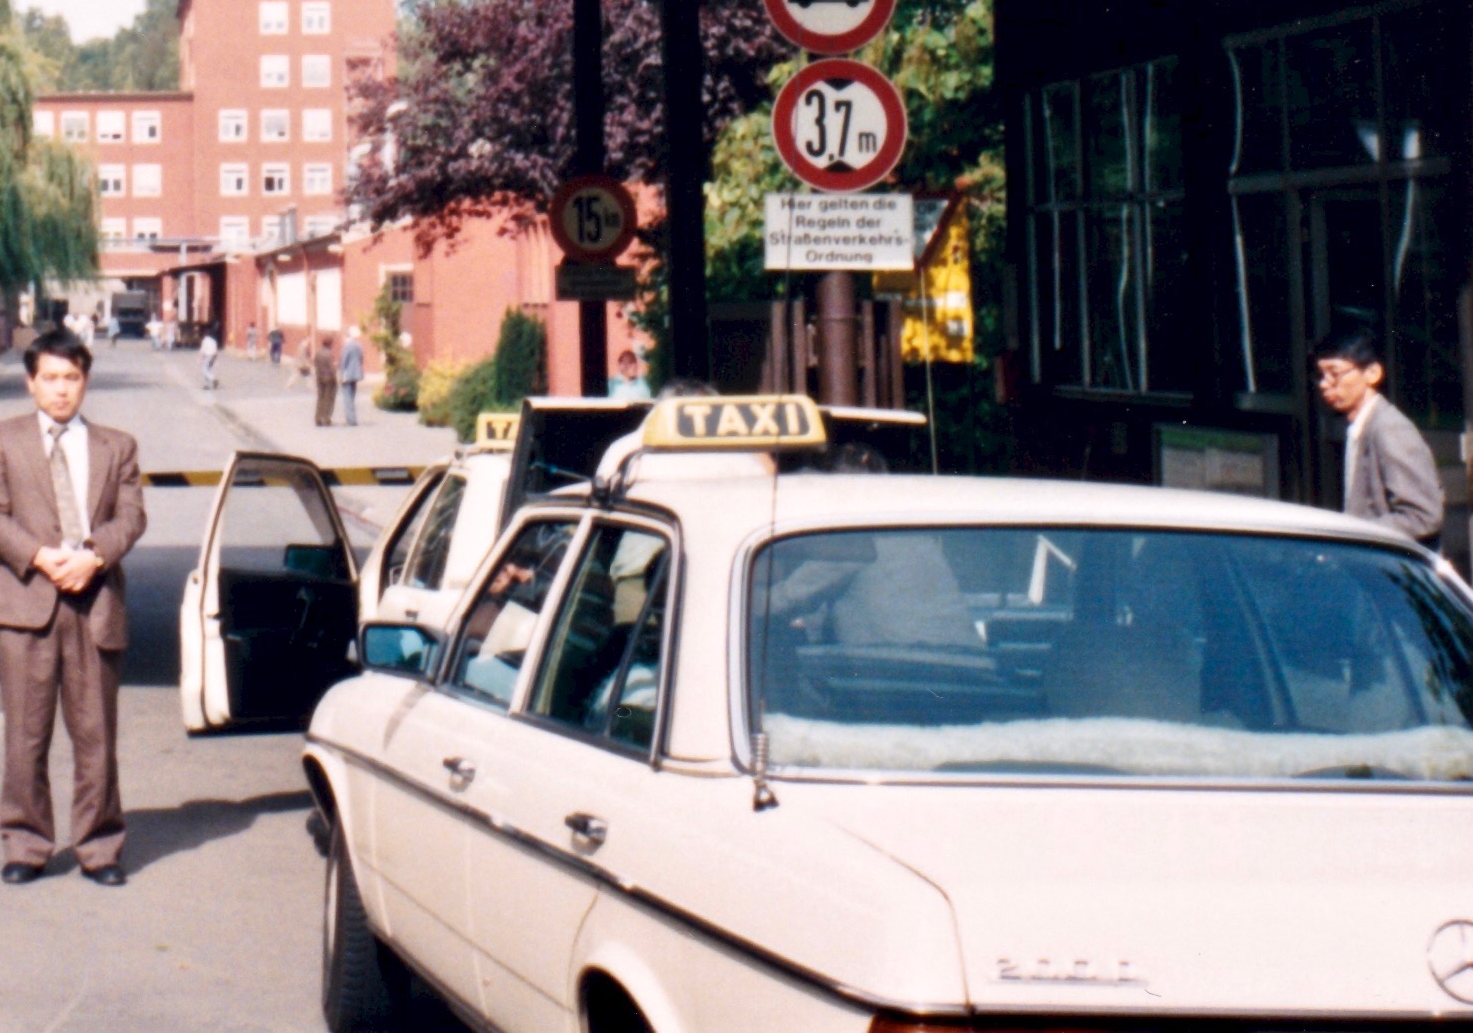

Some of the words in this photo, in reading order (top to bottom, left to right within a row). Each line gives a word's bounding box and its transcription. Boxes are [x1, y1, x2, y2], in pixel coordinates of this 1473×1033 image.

[858, 131, 878, 154] m
[780, 197, 812, 210] Hier
[818, 197, 870, 213] gelten
[872, 197, 897, 210] die
[573, 195, 603, 244] 15
[795, 215, 850, 232] Regeln
[855, 216, 881, 229] der
[805, 250, 873, 264] Ordnung
[682, 403, 802, 437] TAXI
